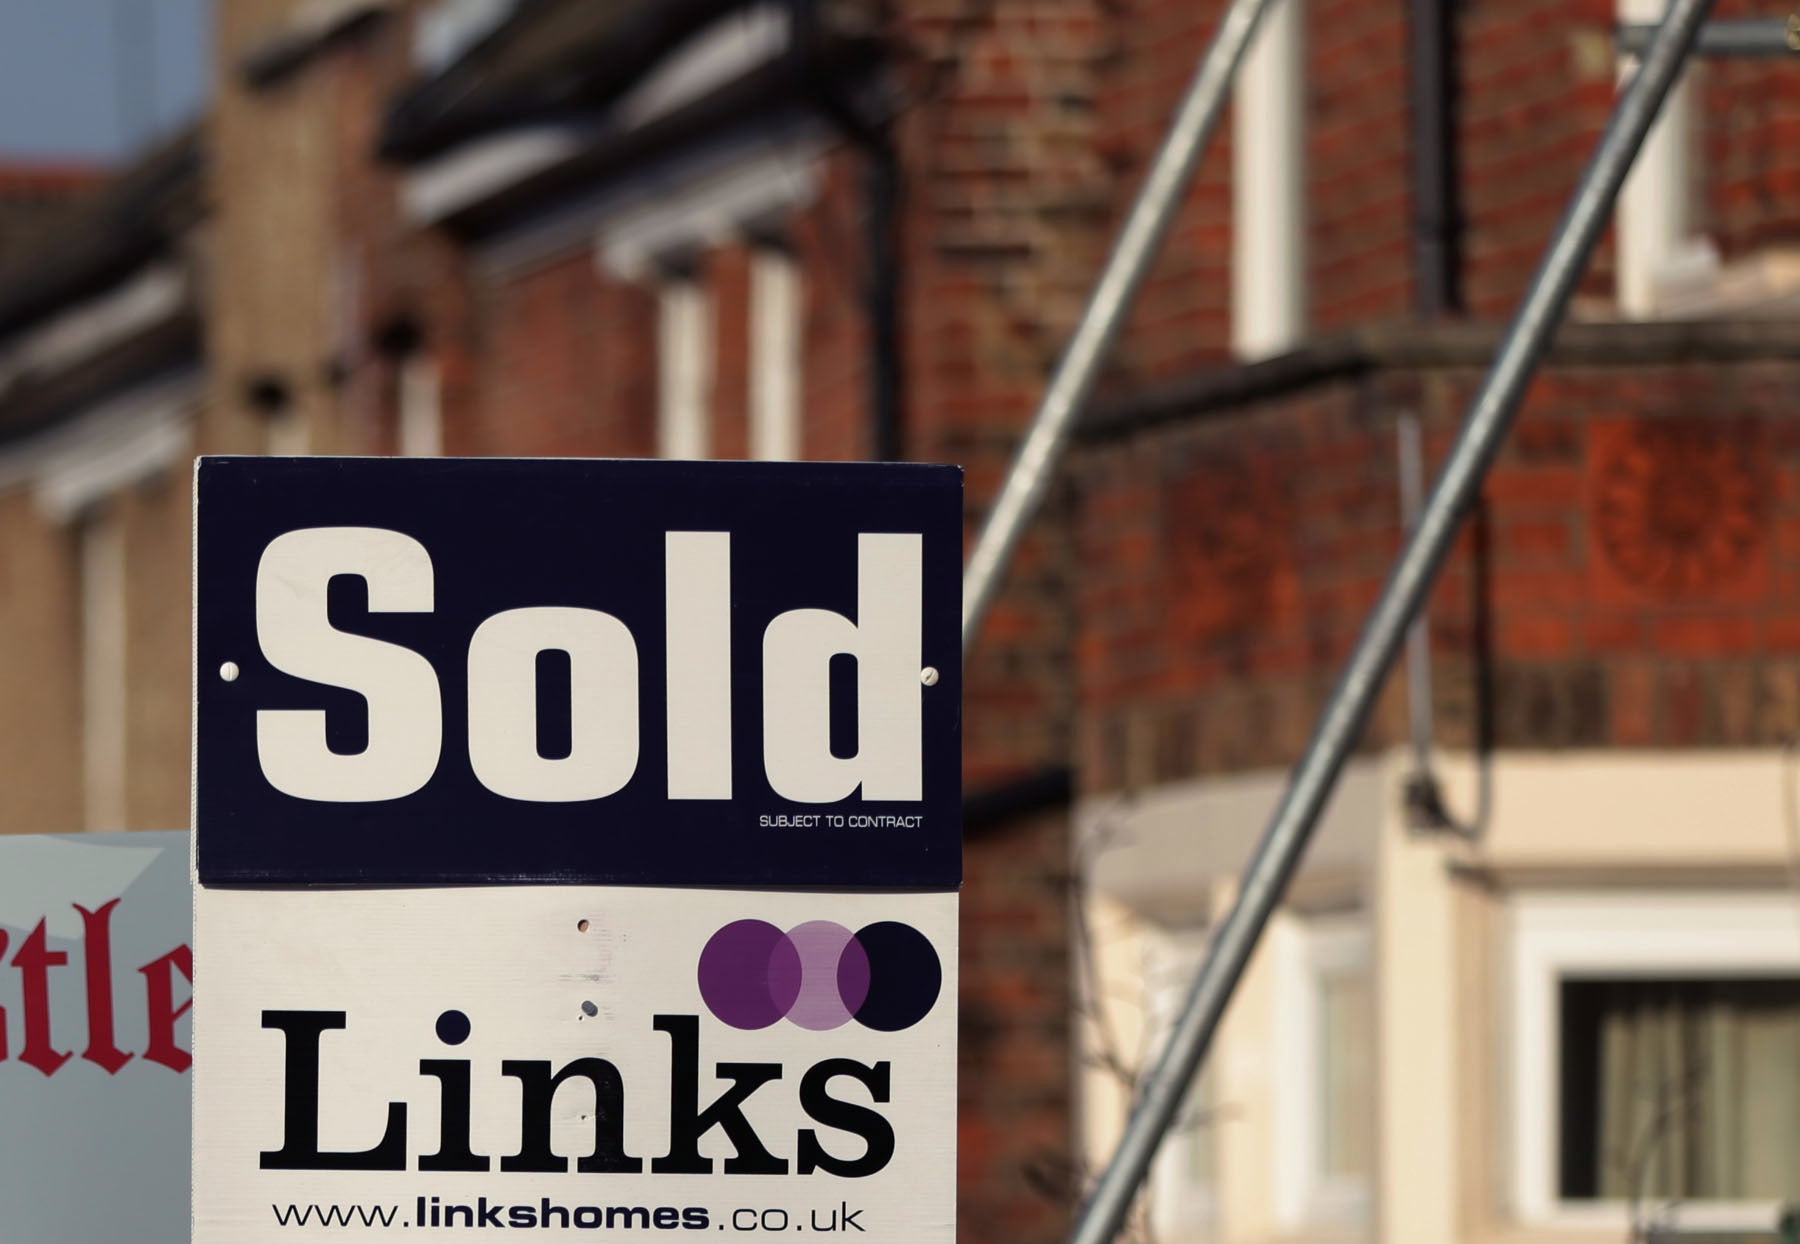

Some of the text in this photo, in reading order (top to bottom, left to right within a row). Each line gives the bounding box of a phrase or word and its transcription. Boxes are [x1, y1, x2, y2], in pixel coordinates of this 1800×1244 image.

[255, 526, 923, 804] Sold
[759, 814, 923, 829] SUBJECT TO CONTRACT
[259, 1009, 896, 1179] Links
[271, 1196, 866, 1232] www.linkshomes.co.uk
